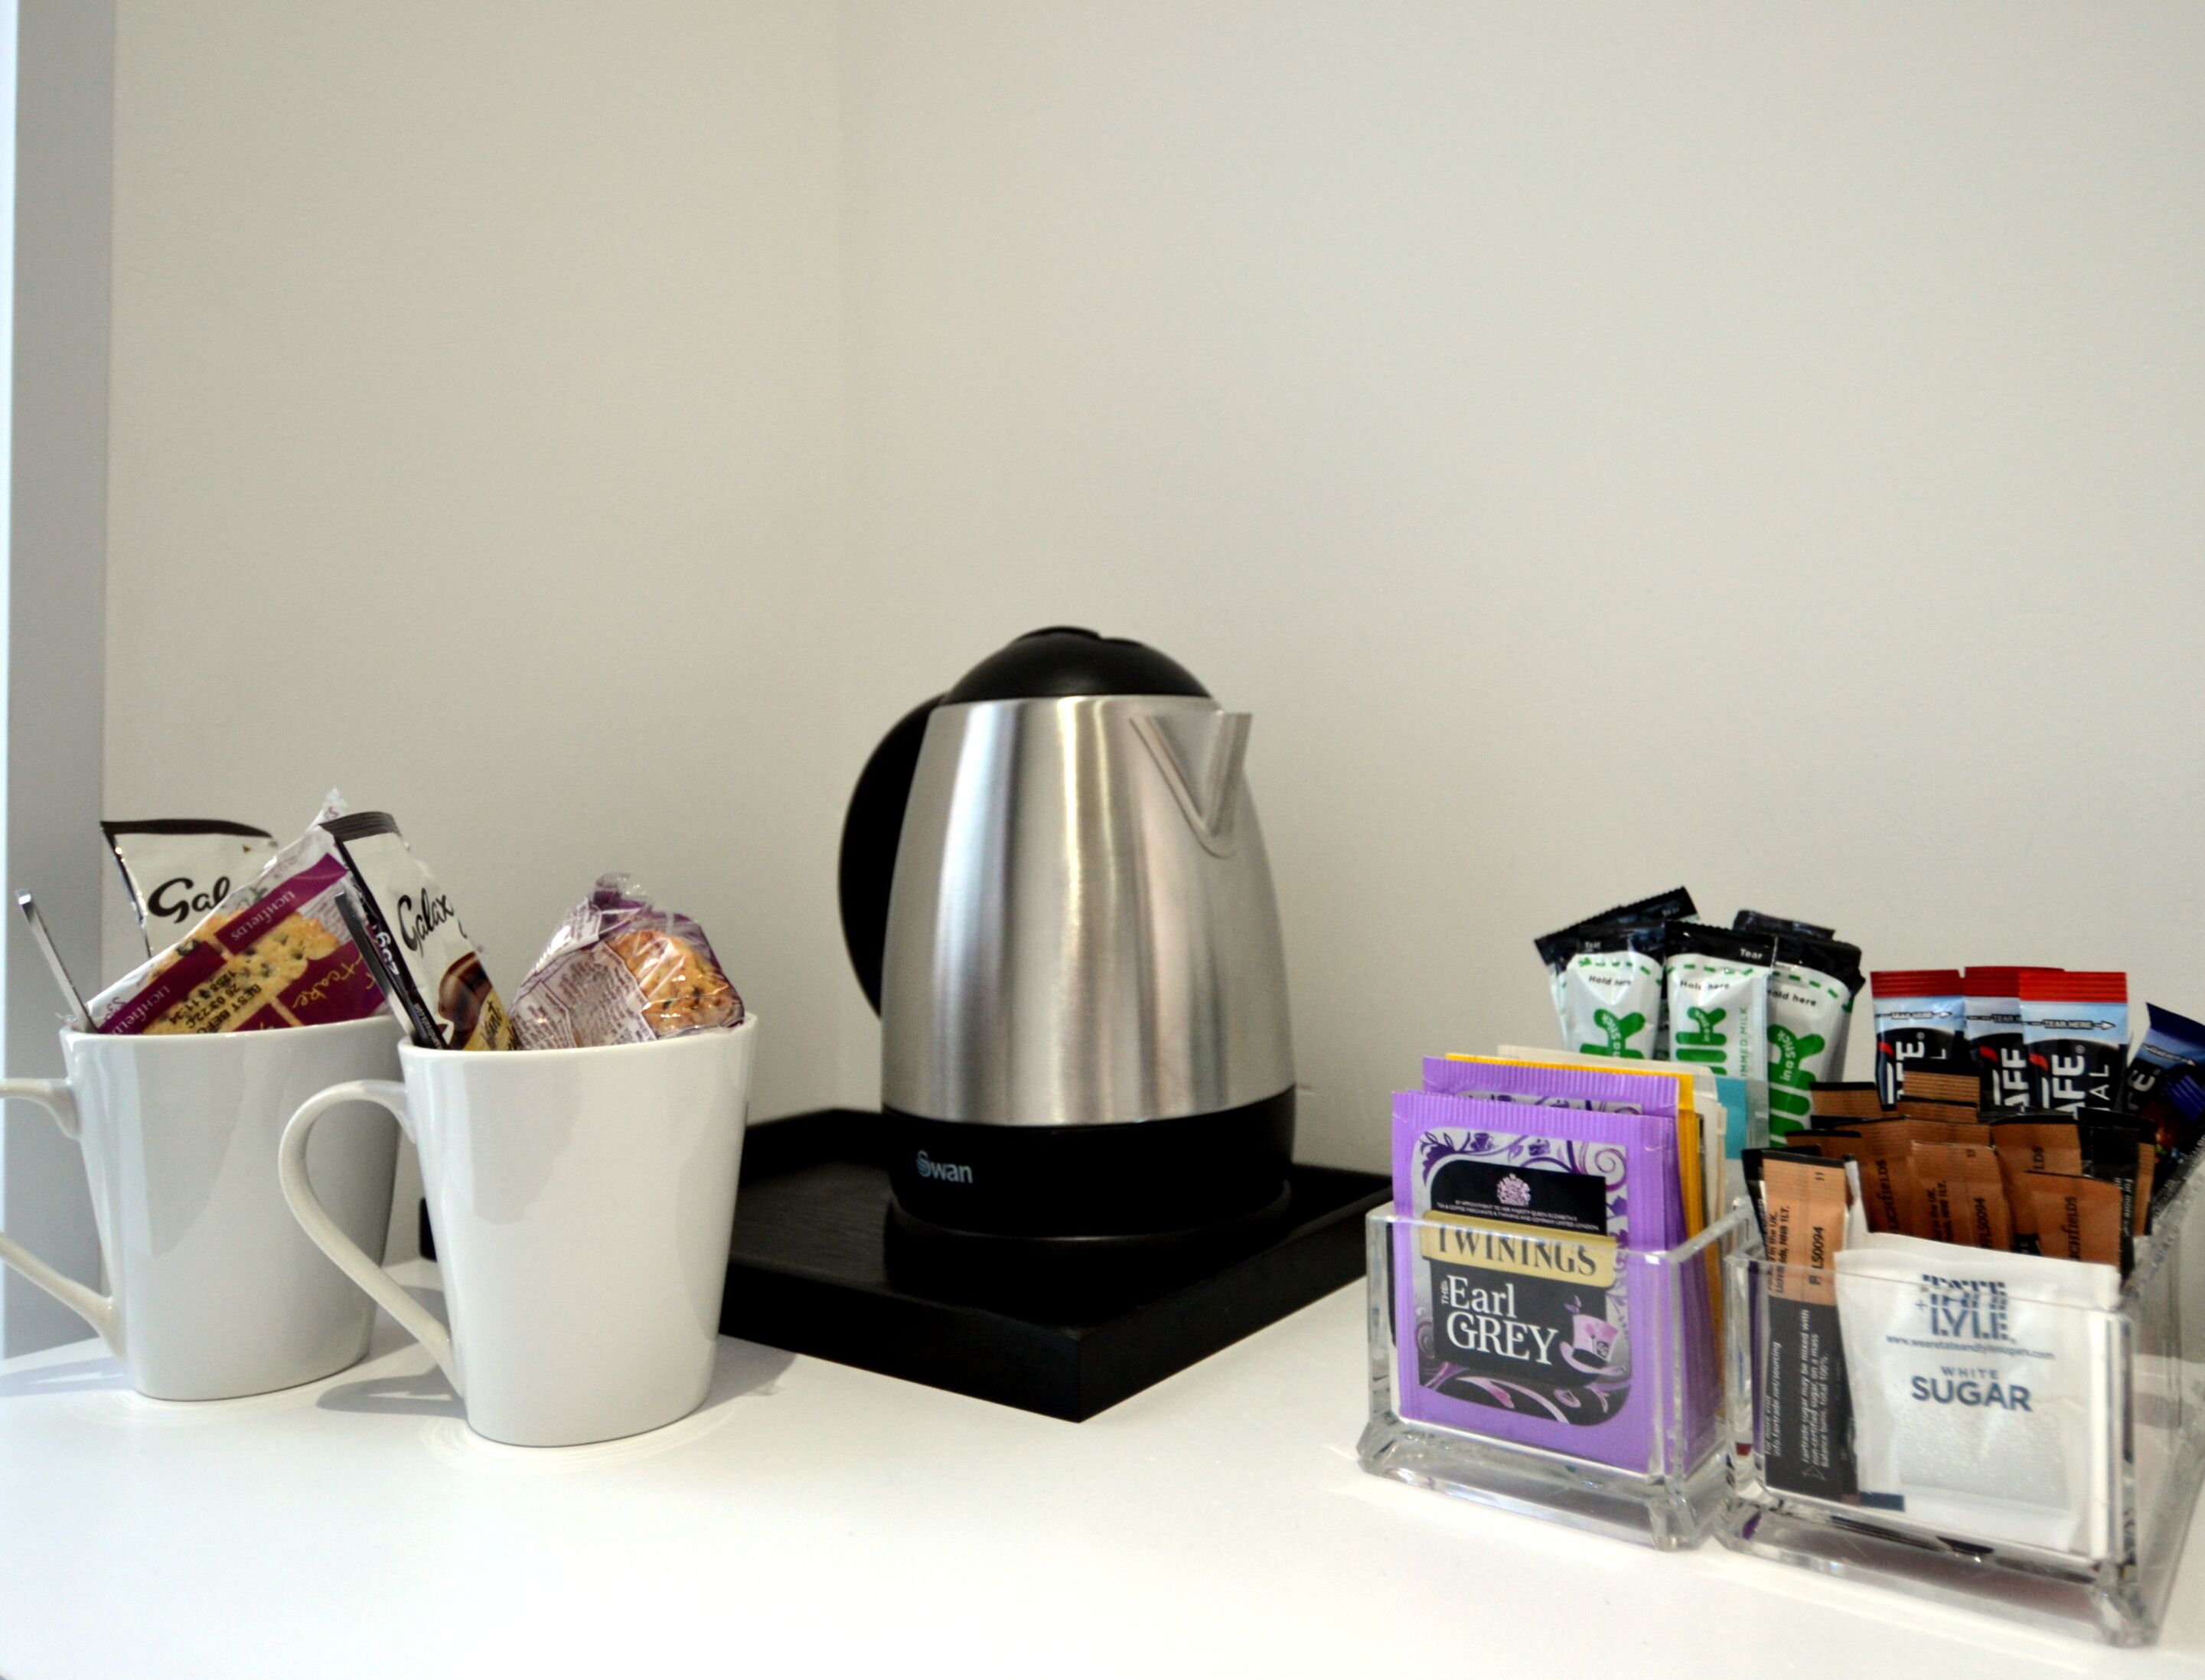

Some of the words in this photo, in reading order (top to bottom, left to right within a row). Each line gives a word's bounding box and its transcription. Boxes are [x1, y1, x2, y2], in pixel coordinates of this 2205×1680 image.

[1739, 948, 1763, 960] Tear
[1588, 975, 1612, 985] Hold
[1792, 994, 1817, 1007] here
[197, 1010, 232, 1033] BEFO
[1739, 1007, 1748, 1036] MILK
[2044, 1019, 2068, 1029] TEAR
[2069, 1019, 2094, 1029] HERE
[1740, 1038, 1749, 1077] IMMED
[1779, 1071, 1792, 1081] in
[917, 1150, 973, 1184] Swan
[1447, 1274, 1517, 1320] Earl
[1800, 1309, 1810, 1331] with
[1447, 1311, 1558, 1366] GREY
[1800, 1333, 1809, 1362] mixed
[1940, 1365, 1999, 1380] WHITE
[1800, 1376, 1812, 1397] may
[1910, 1375, 2033, 1412] SUGAR
